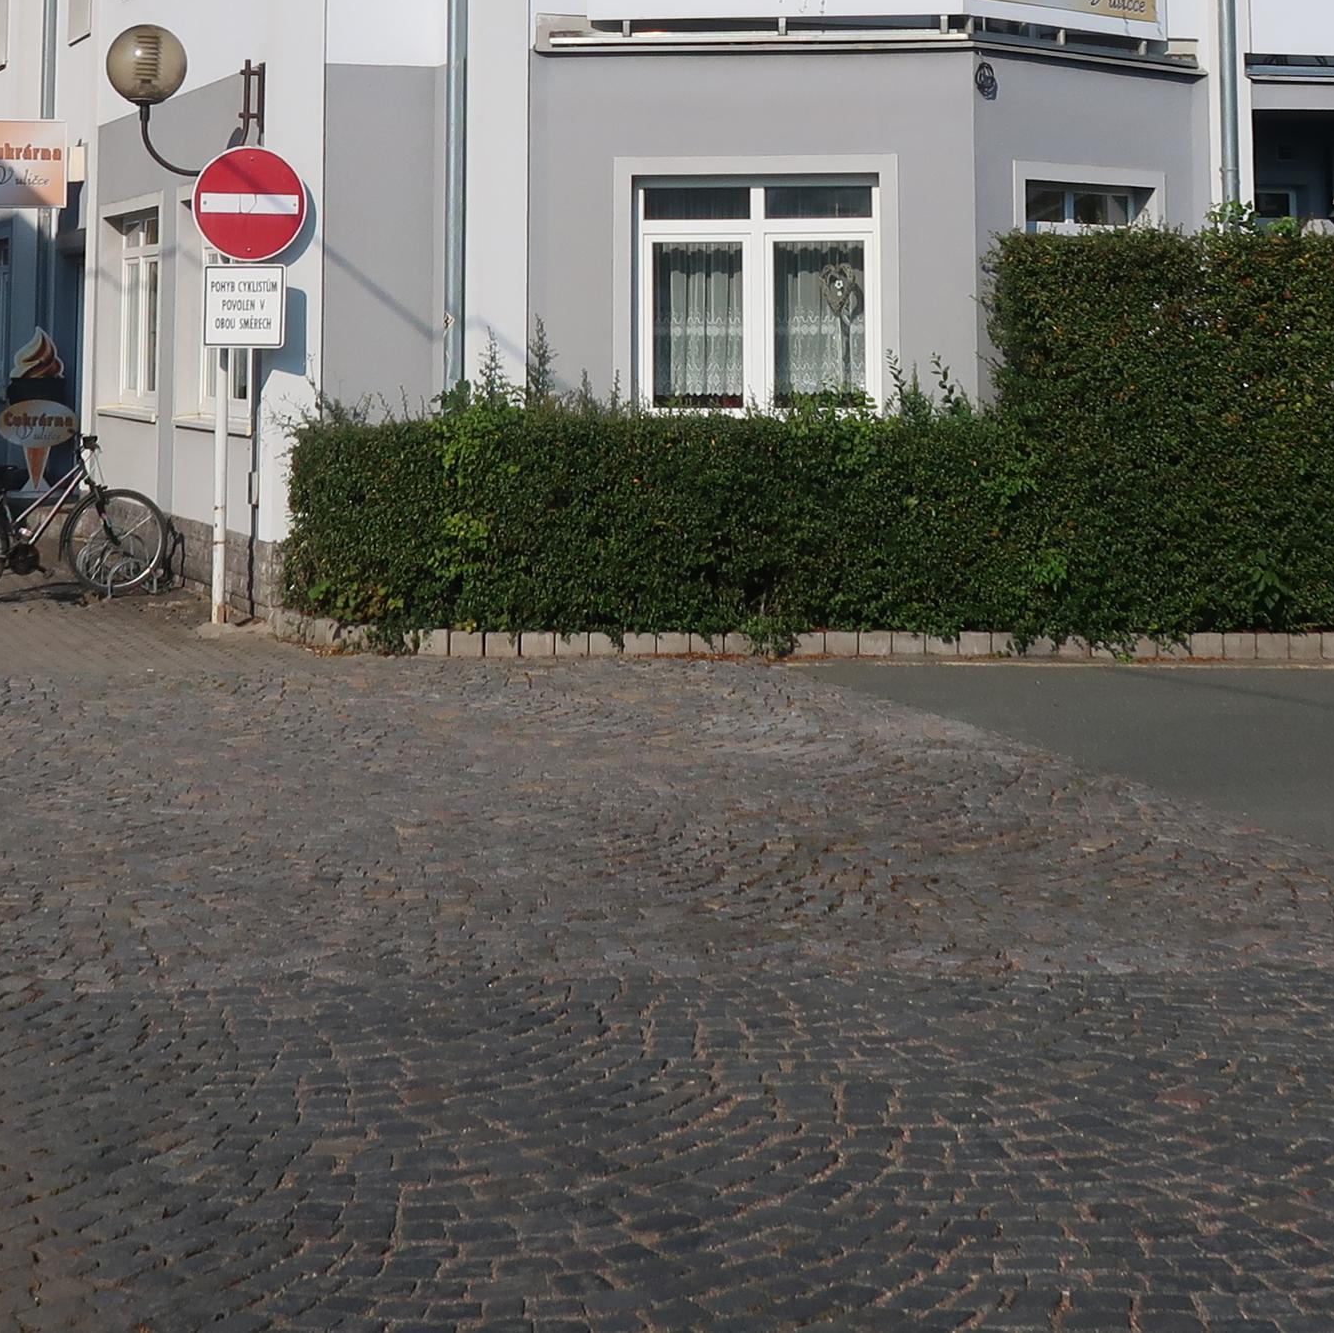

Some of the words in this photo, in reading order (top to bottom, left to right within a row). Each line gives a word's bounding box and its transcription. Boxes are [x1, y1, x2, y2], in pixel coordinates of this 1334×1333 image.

[210, 281, 235, 293] POHYB
[238, 278, 277, 293] CYKLISTŮM
[221, 299, 255, 311] POVOLEN
[259, 299, 266, 310] V
[214, 317, 236, 329] OBOU
[239, 315, 272, 329] SMĚRECH
[3, 411, 73, 427] Cukrárna
